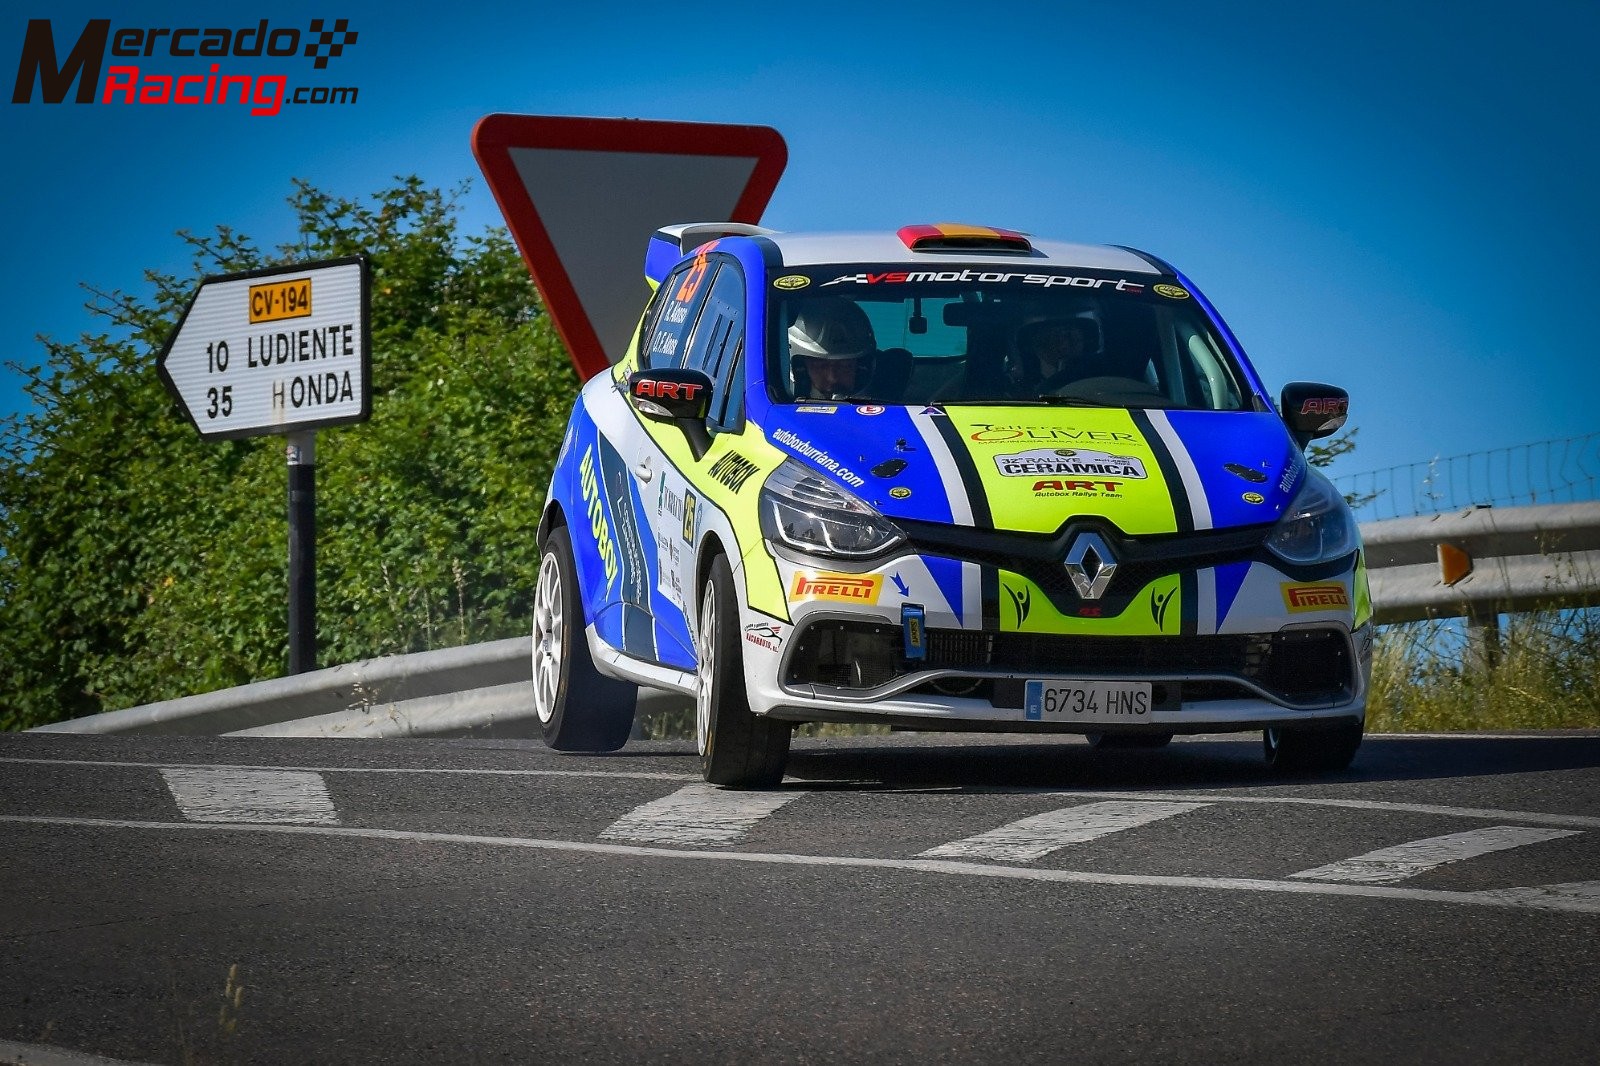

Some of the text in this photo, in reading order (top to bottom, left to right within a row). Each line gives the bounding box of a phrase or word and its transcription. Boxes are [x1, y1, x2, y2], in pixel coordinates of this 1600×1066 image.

[252, 286, 309, 316] CV-194
[207, 324, 354, 373] 10 LUDIENTE
[207, 371, 354, 419] 35 HONDA
[636, 379, 703, 400] ART
[773, 428, 864, 488] autoboxburriana.com
[1004, 463, 1140, 476] CERAMICA
[708, 450, 760, 495] AUTOBOX
[1032, 480, 1123, 492] ART
[580, 443, 618, 602] AUTOBOX
[796, 577, 875, 599] PIRELLI
[1288, 587, 1347, 607] PIRELLI
[1030, 703, 1038, 714] E
[1044, 689, 1147, 715] 6734 HNS
